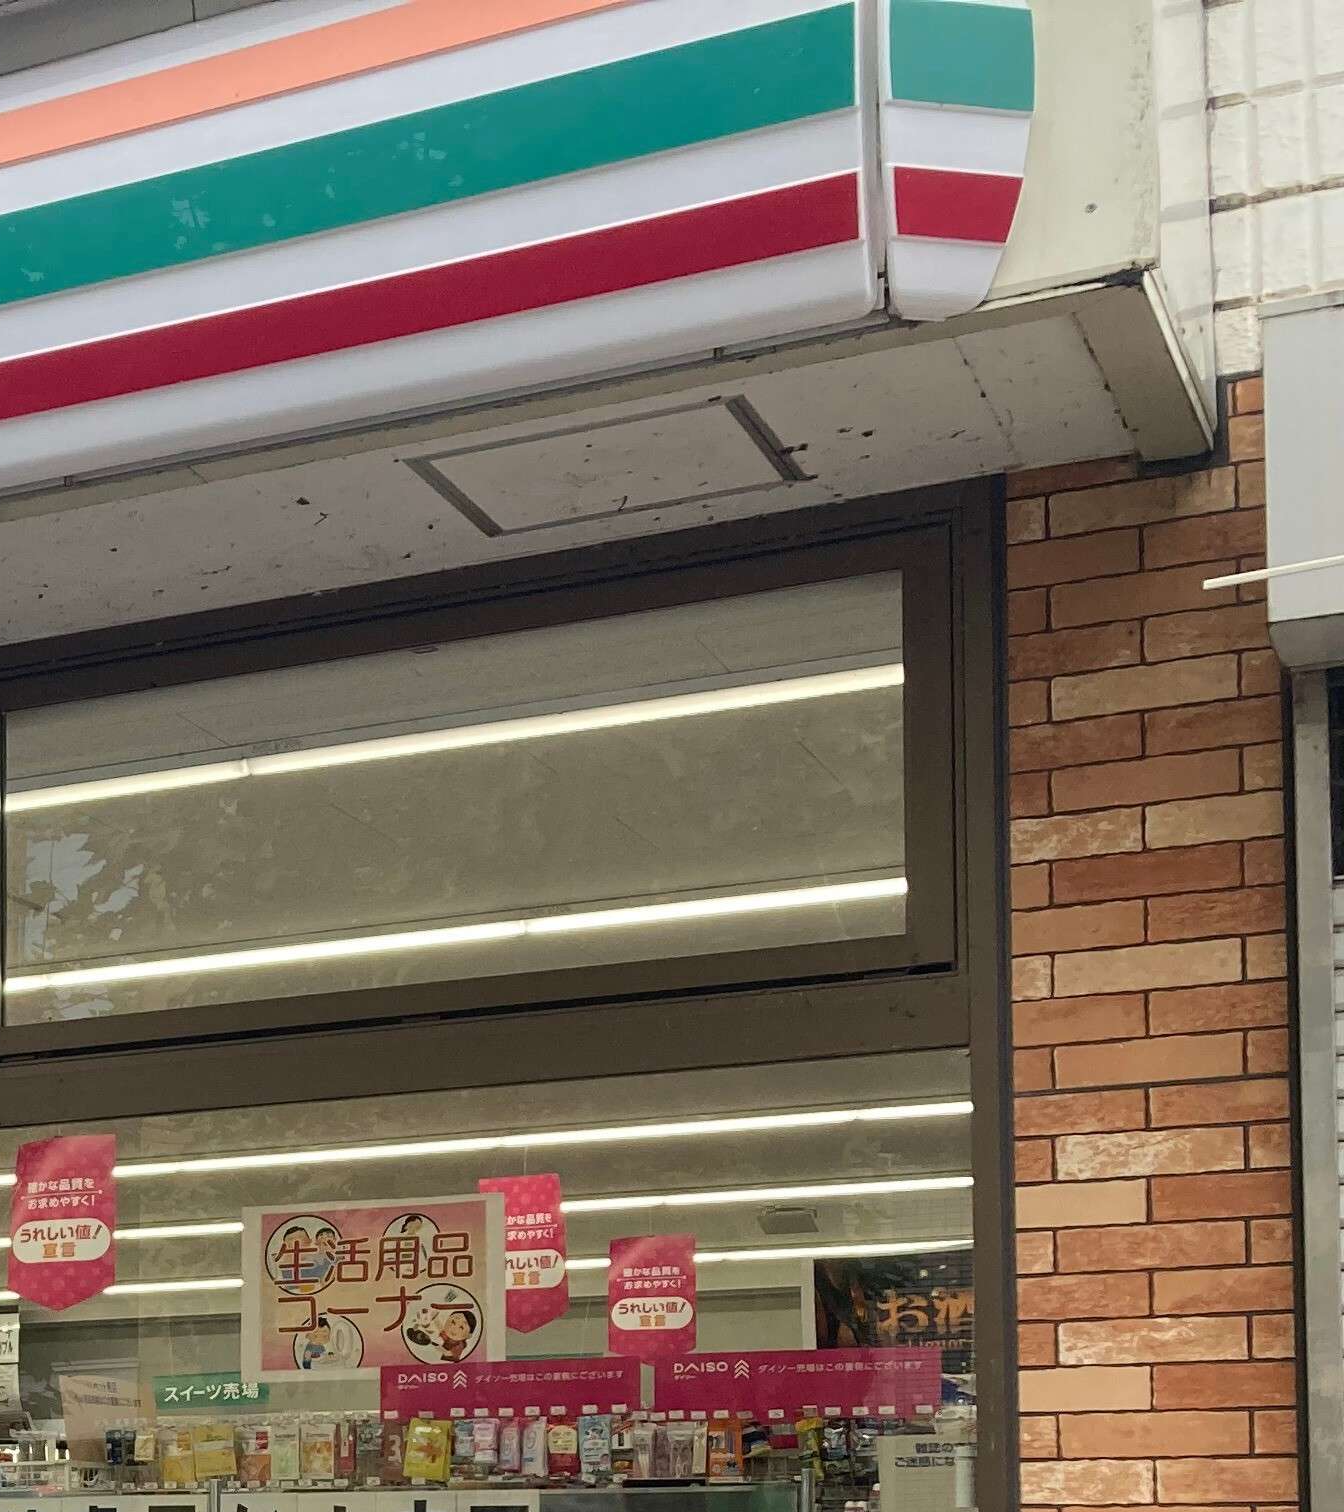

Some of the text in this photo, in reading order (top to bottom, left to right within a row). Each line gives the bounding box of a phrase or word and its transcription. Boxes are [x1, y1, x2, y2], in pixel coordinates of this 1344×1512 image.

[505, 1213, 553, 1225] かな品質を
[43, 1242, 76, 1258] 宣言
[272, 1232, 474, 1286] 生活用品
[277, 1286, 474, 1333] コーナー
[673, 1362, 729, 1374] DAISO
[398, 1372, 448, 1385] DAISO
[164, 1382, 261, 1402] スイーツ売場
